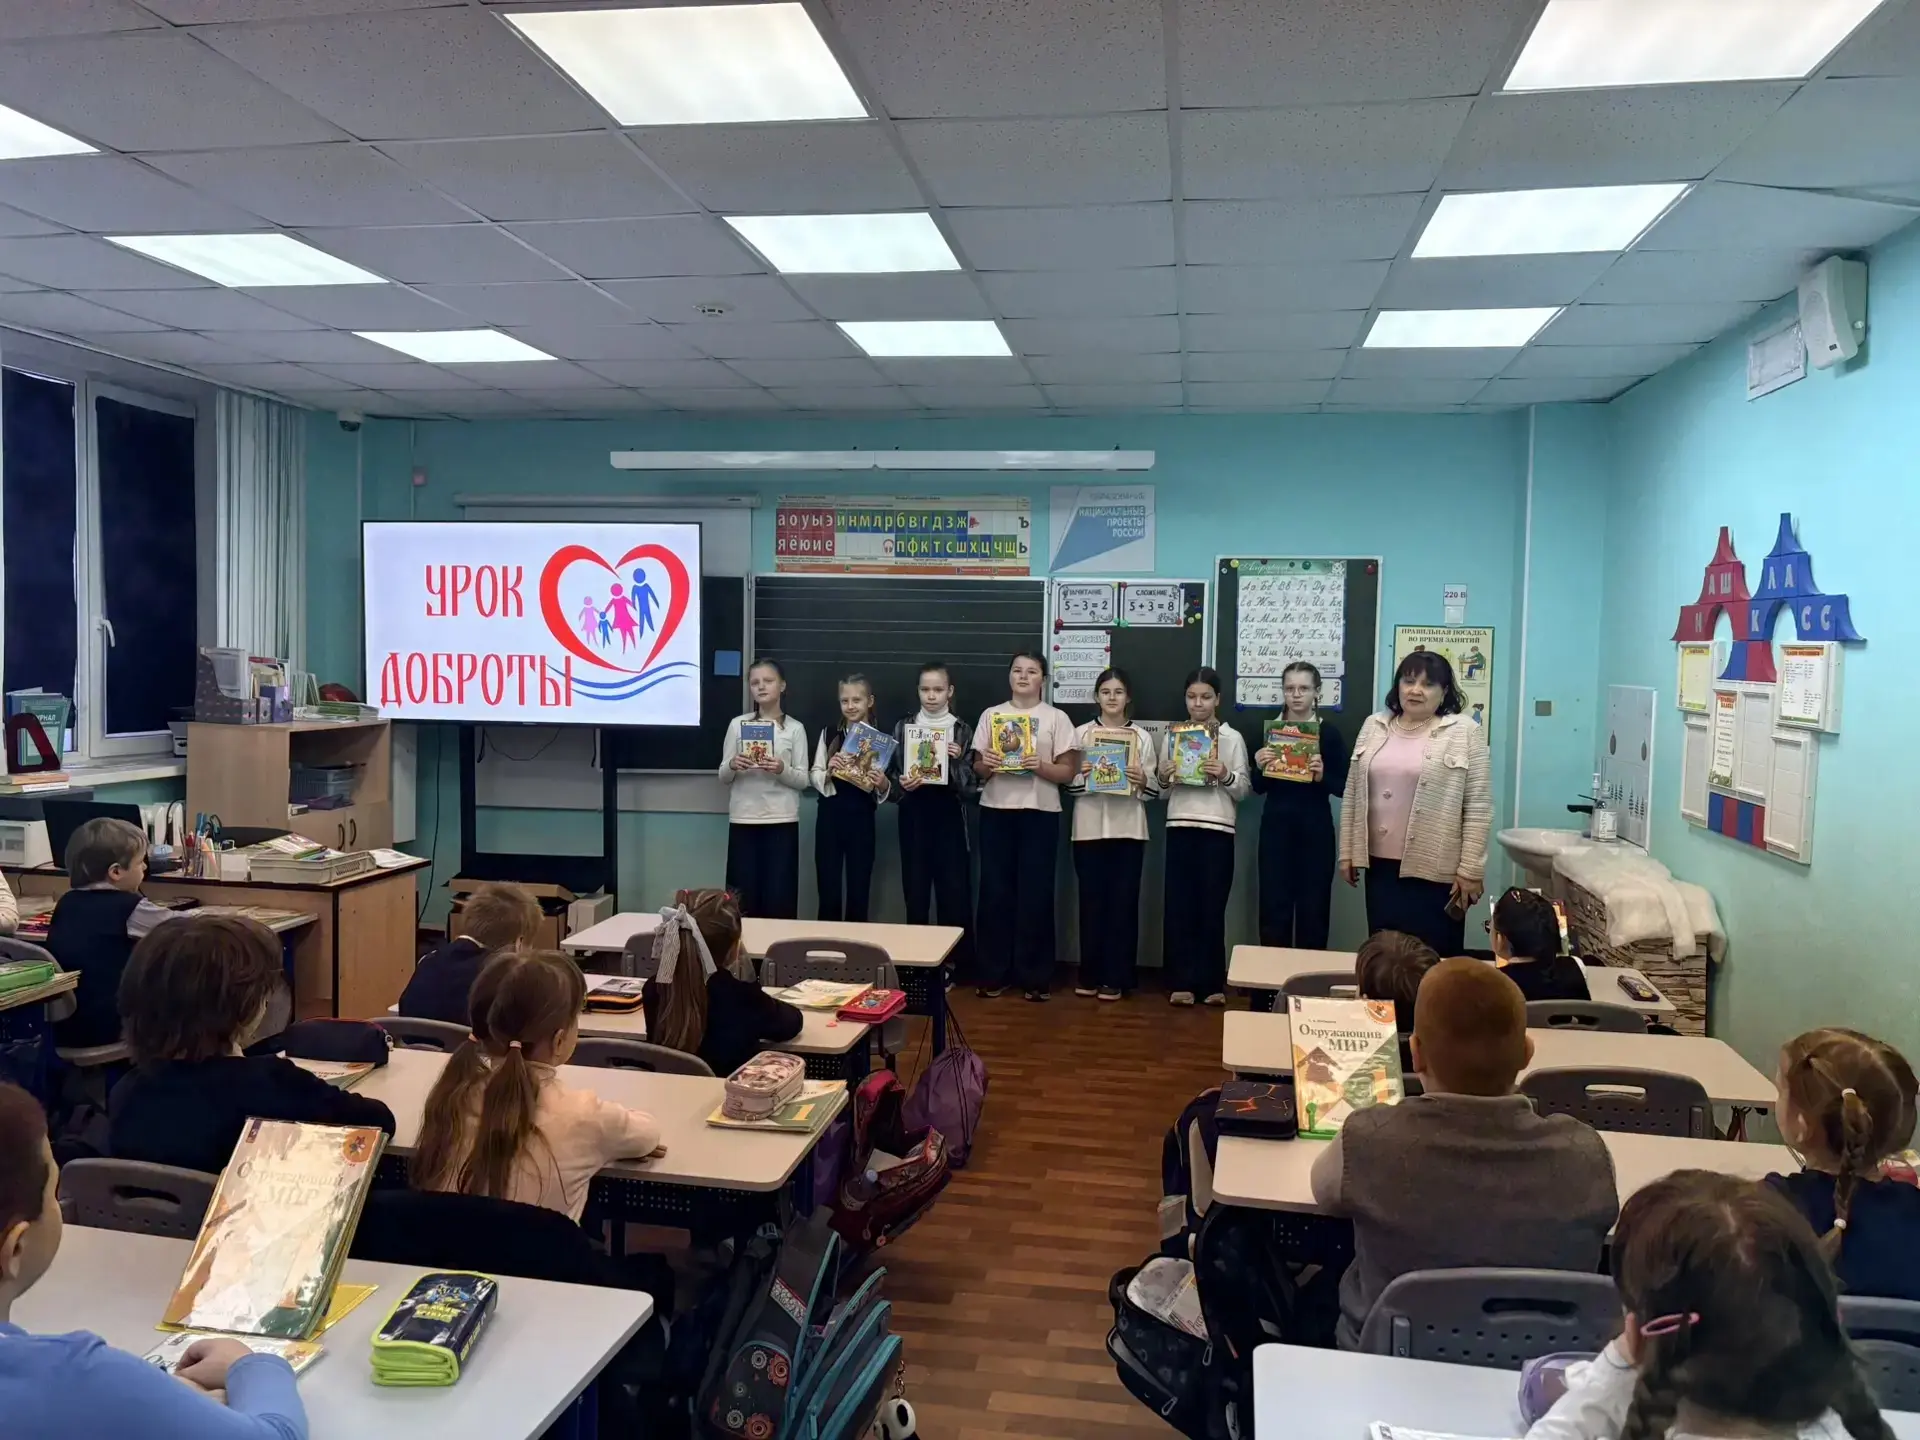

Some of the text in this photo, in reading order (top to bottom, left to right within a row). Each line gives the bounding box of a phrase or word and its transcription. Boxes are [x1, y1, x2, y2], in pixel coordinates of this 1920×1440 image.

[1079, 506, 1144, 517] НАЦИОНАЛЬНЫЕ
[1106, 517, 1144, 526] ПРОЕКТЫ
[1112, 528, 1144, 537] РОССИИ
[1242, 581, 1256, 591] Аа
[1260, 580, 1275, 590] Бб
[426, 565, 523, 618] УРОК
[1065, 601, 1070, 610] 5
[1082, 601, 1088, 610] 3
[1101, 600, 1108, 610] 2
[1129, 602, 1135, 611] 5
[1148, 602, 1154, 611] 3
[1168, 602, 1174, 611] 8
[1255, 597, 1276, 607] Жж
[1257, 613, 1277, 623] Мм
[1253, 629, 1272, 639] Тт
[1257, 646, 1277, 656] Шш
[1283, 646, 1303, 659] Щщ
[381, 652, 572, 709] ДОБРОТЫ
[1334, 681, 1340, 691] 2
[1241, 694, 1246, 702] 3
[1271, 694, 1277, 702] 5
[1333, 695, 1339, 703] 9
[1299, 1024, 1382, 1039] Окружающий
[1328, 1039, 1369, 1051] МИР
[785, 1103, 816, 1121] 1
